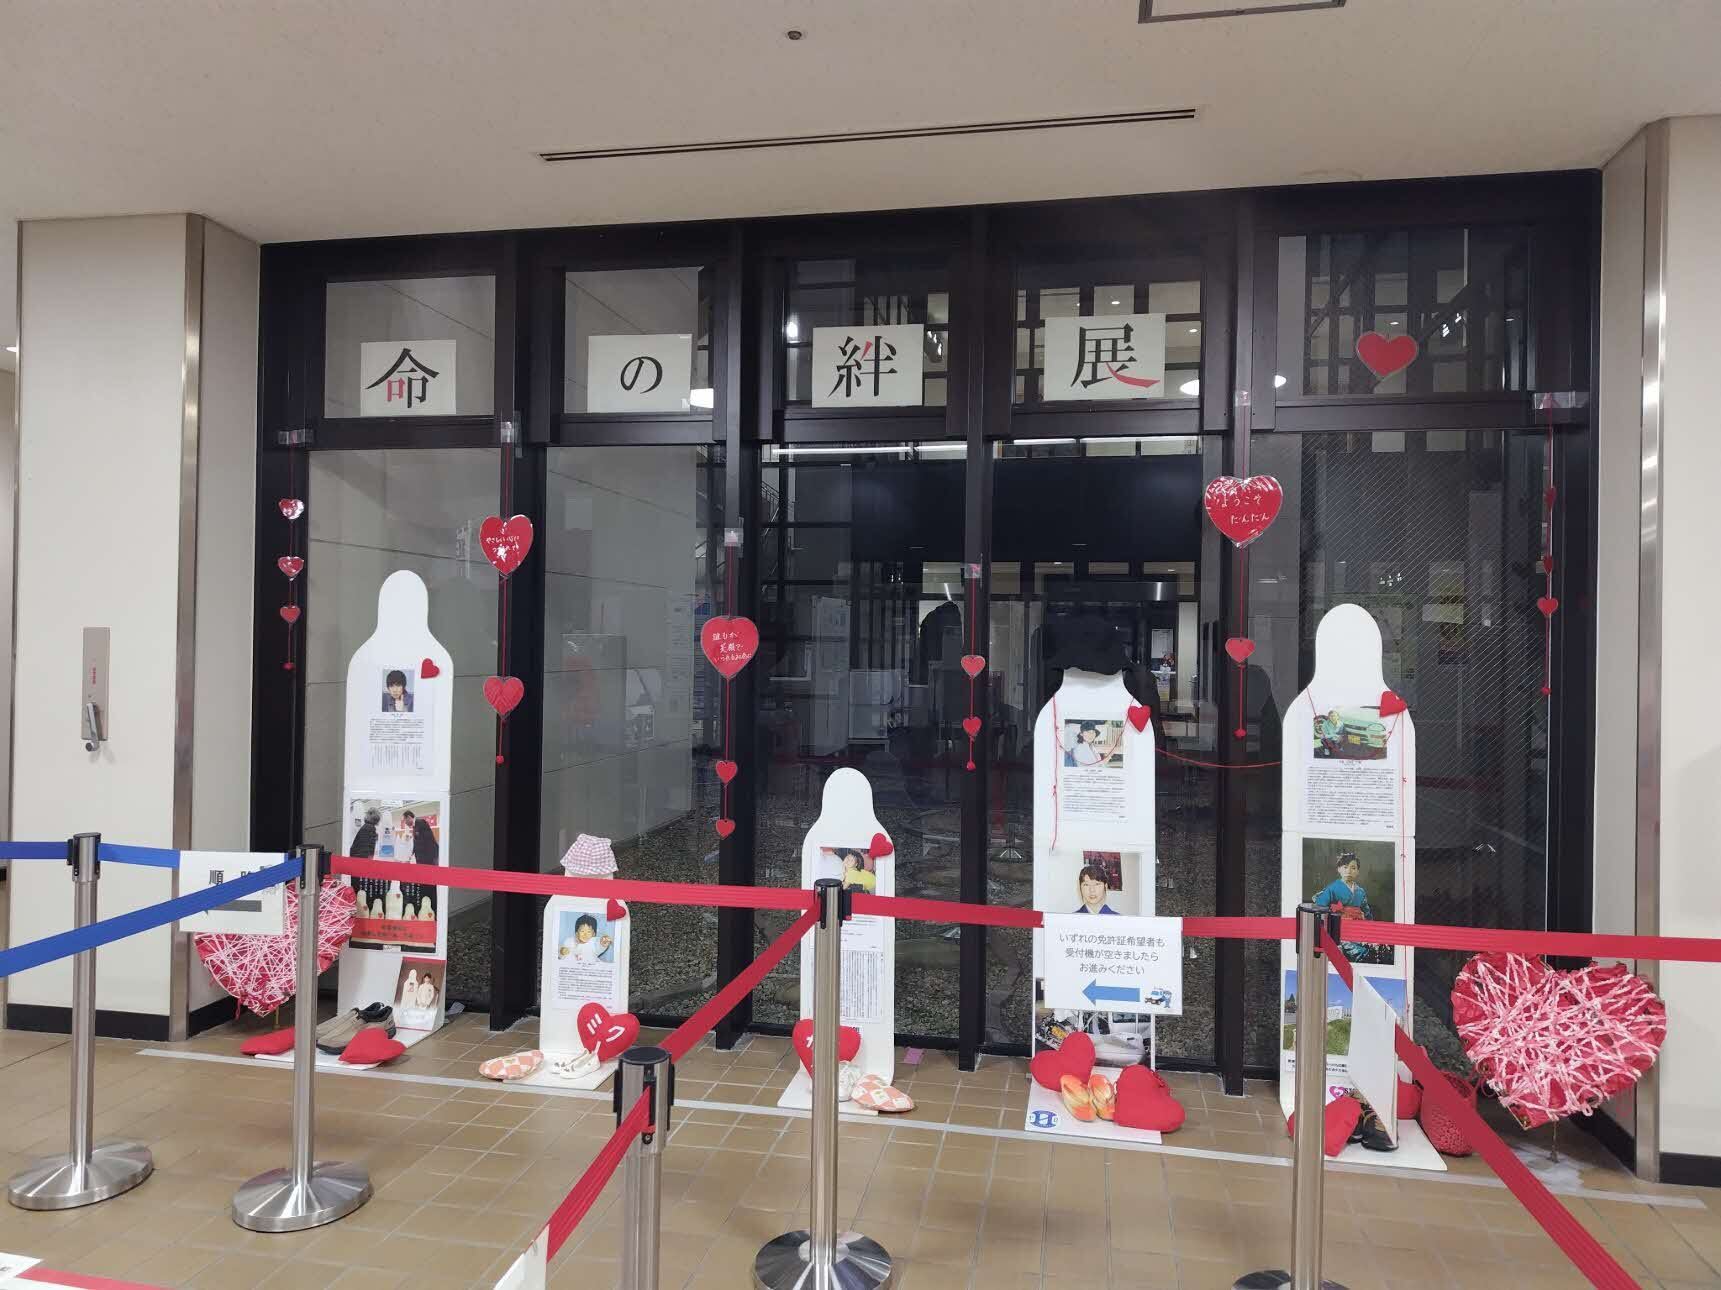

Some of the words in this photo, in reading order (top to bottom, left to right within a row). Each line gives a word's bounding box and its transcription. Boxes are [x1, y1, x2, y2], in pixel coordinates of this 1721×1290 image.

[365, 347, 440, 409] 命
[620, 355, 663, 394] の
[828, 335, 898, 398] 絆
[1070, 322, 1160, 389] 展
[1059, 933, 1165, 948] いずれの免許証希望者も
[1064, 947, 1160, 962] 受付機が空きましたら
[1079, 962, 1145, 976] お進みください
